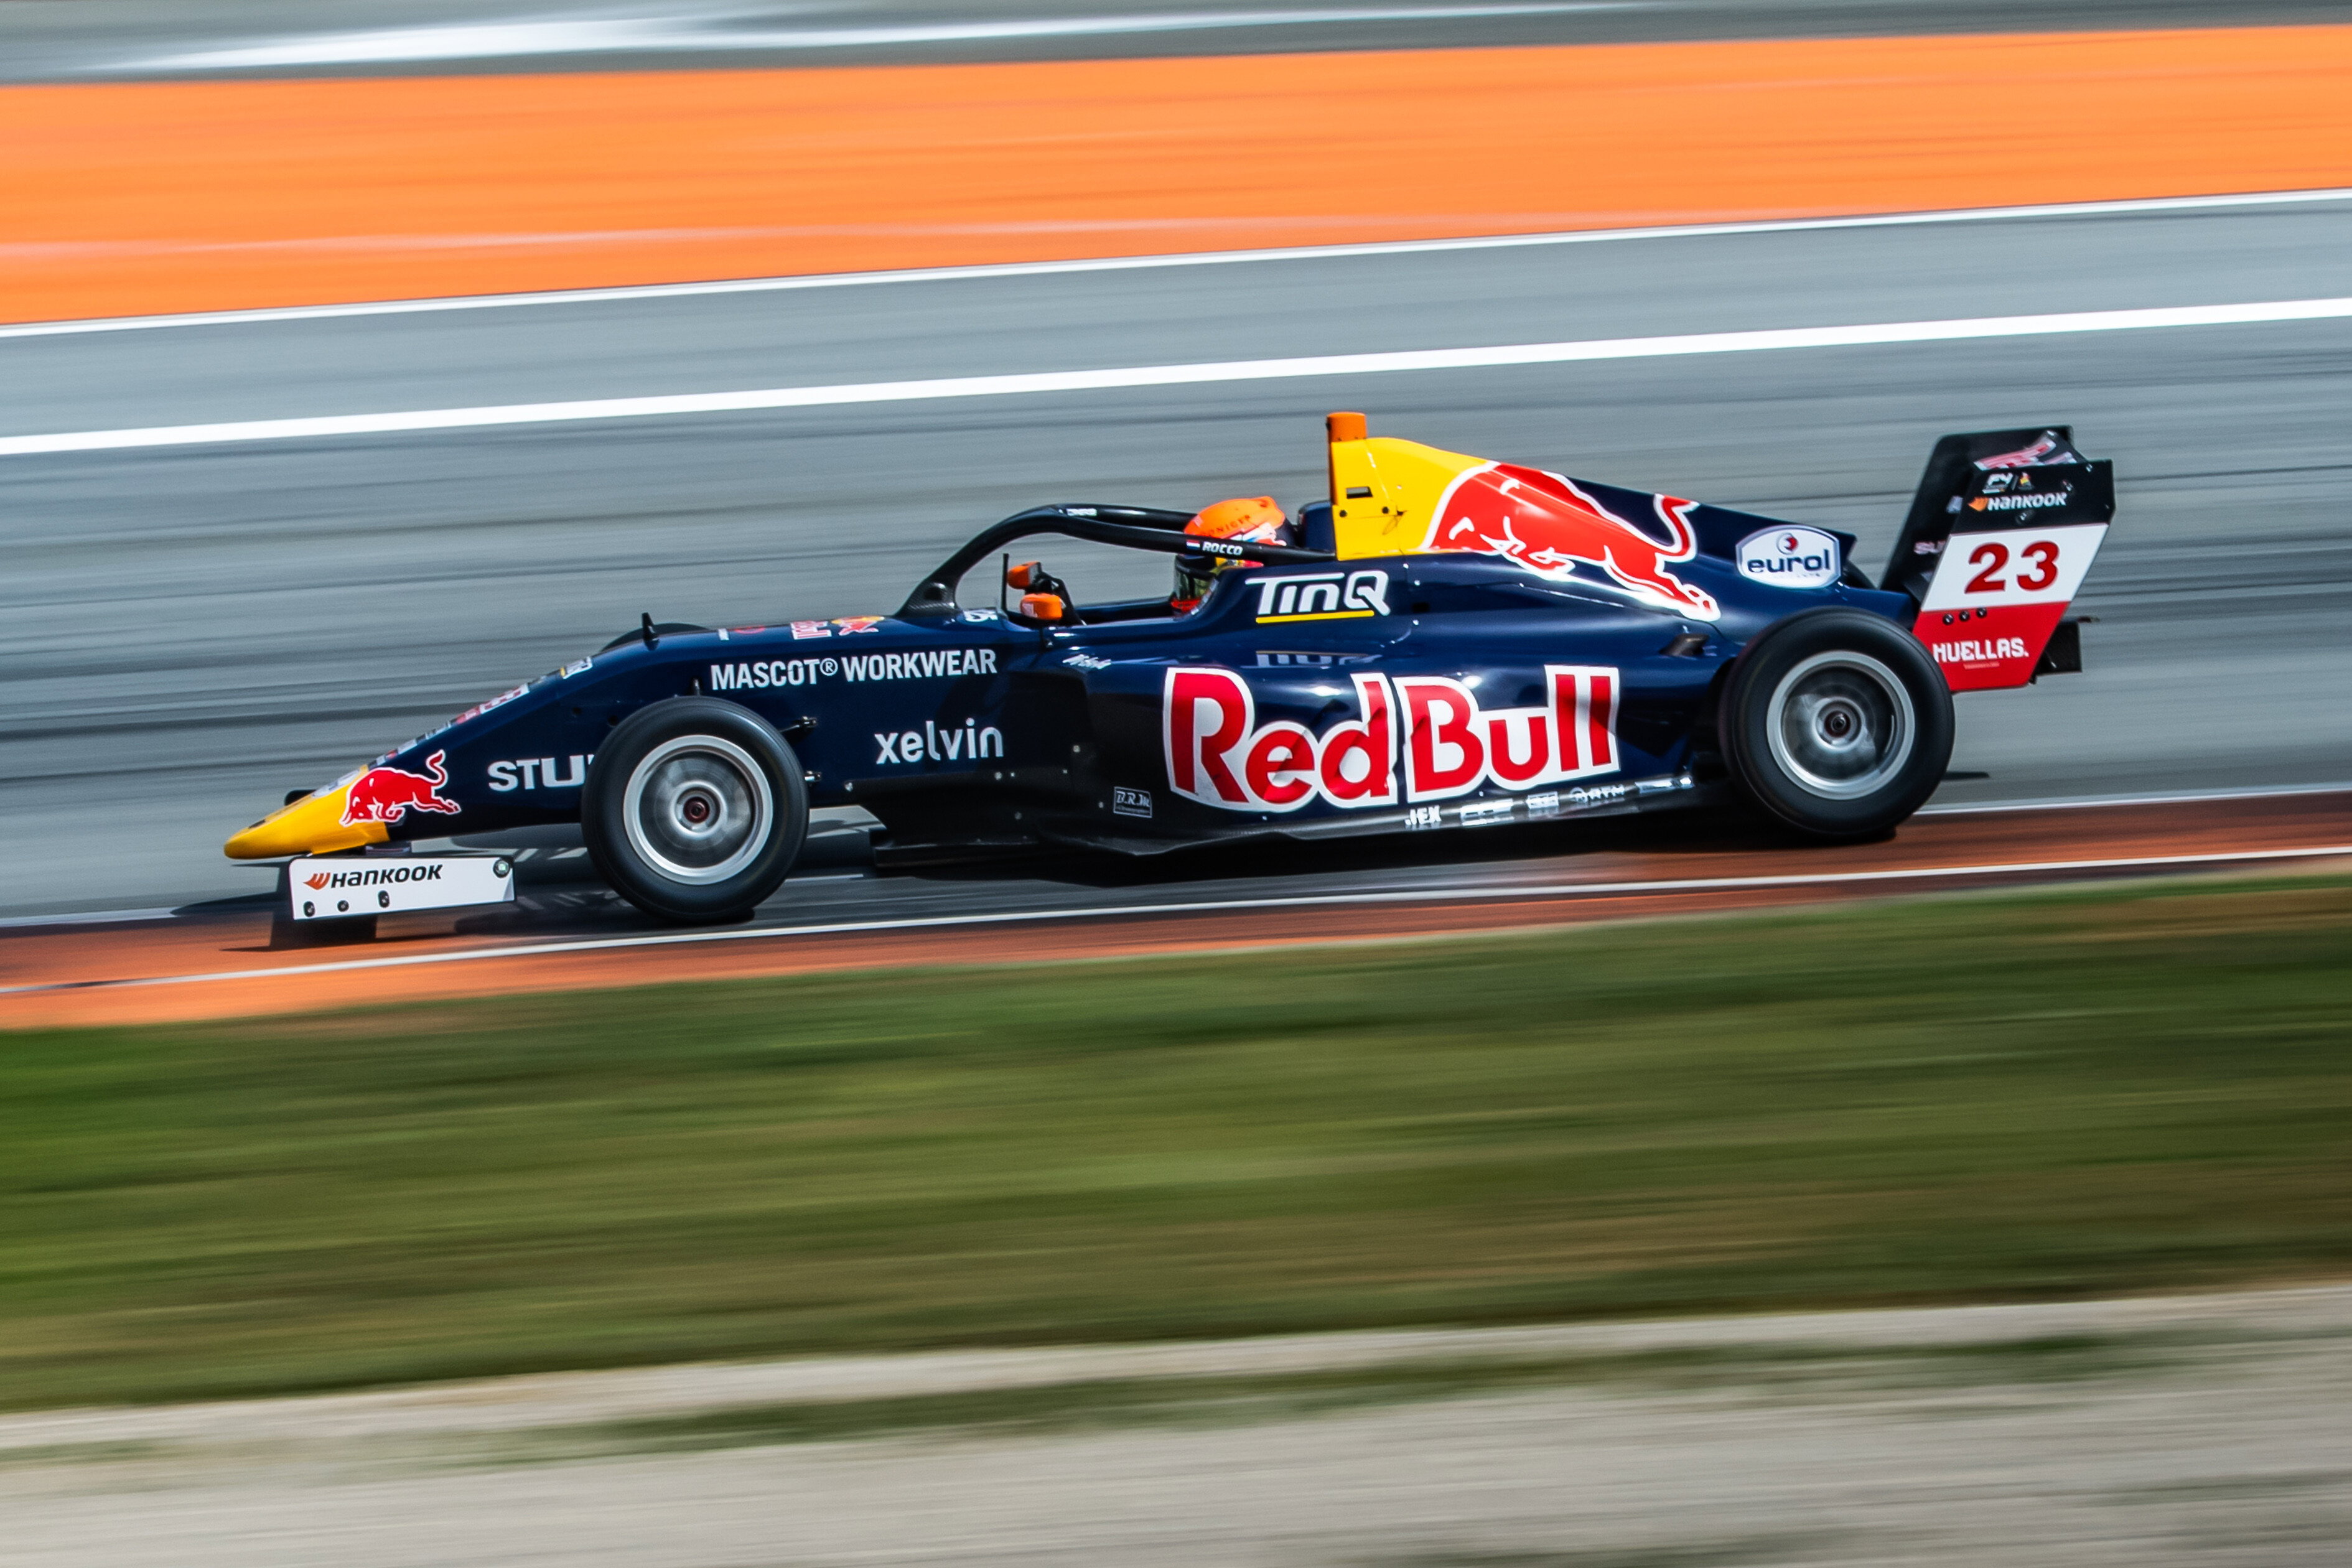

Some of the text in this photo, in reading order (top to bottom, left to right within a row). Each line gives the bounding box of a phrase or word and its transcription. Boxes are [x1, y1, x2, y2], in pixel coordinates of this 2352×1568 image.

[1202, 541, 1243, 556] ROCCO
[1747, 549, 1831, 573] eurol
[1965, 541, 2060, 594] 23
[841, 648, 997, 682] WORKWEAR
[874, 717, 1004, 764] xelvin
[1164, 665, 1621, 812] Red Bull
[488, 754, 594, 791] STU
